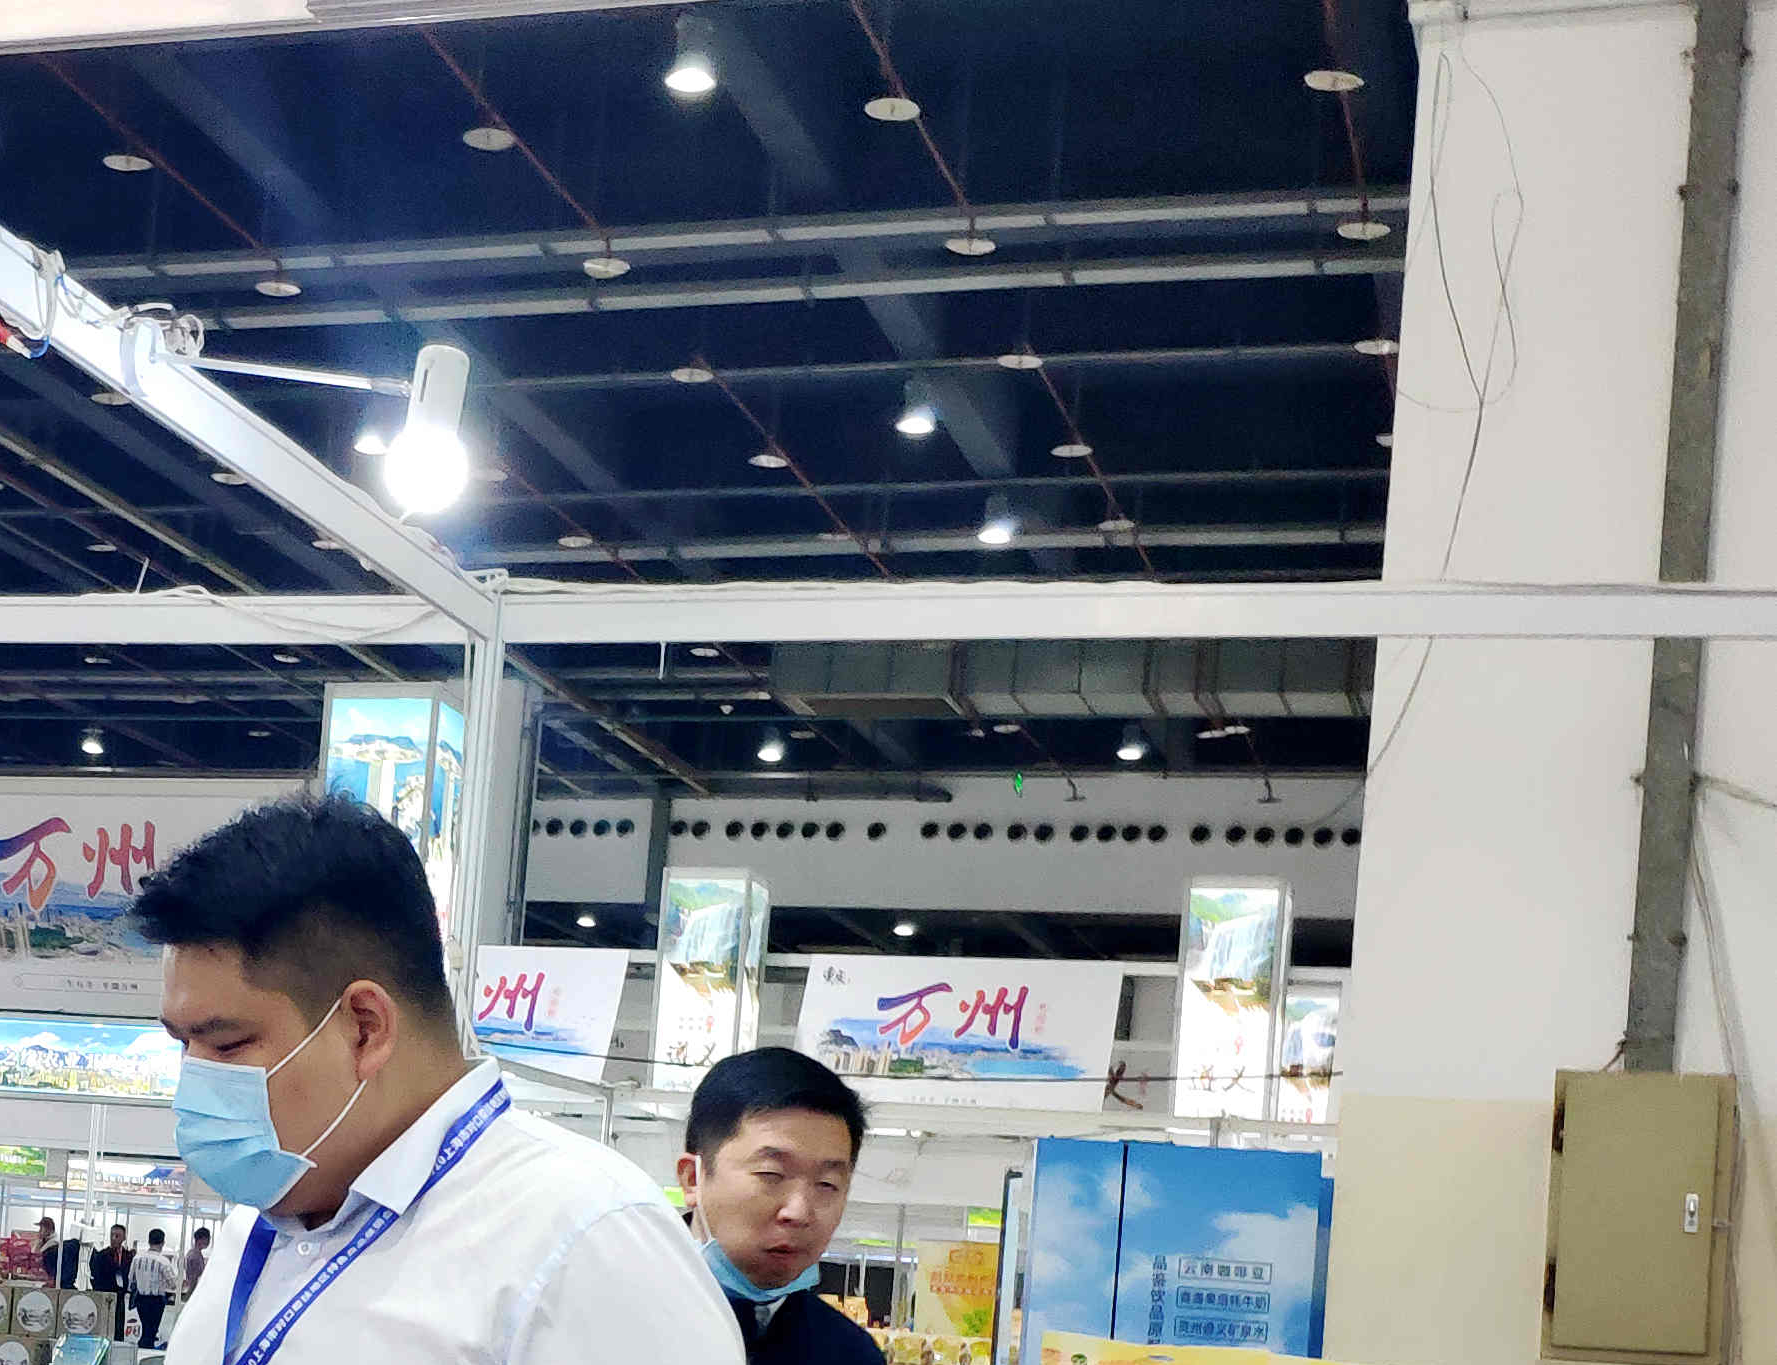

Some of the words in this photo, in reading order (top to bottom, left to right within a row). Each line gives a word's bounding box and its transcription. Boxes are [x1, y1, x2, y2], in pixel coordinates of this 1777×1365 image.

[478, 971, 545, 1032] 州
[876, 981, 1029, 1050] 万州
[1183, 1262, 1265, 1281] 云南咖啡豆
[1178, 1320, 1265, 1338] 贵州遵义矿泉水
